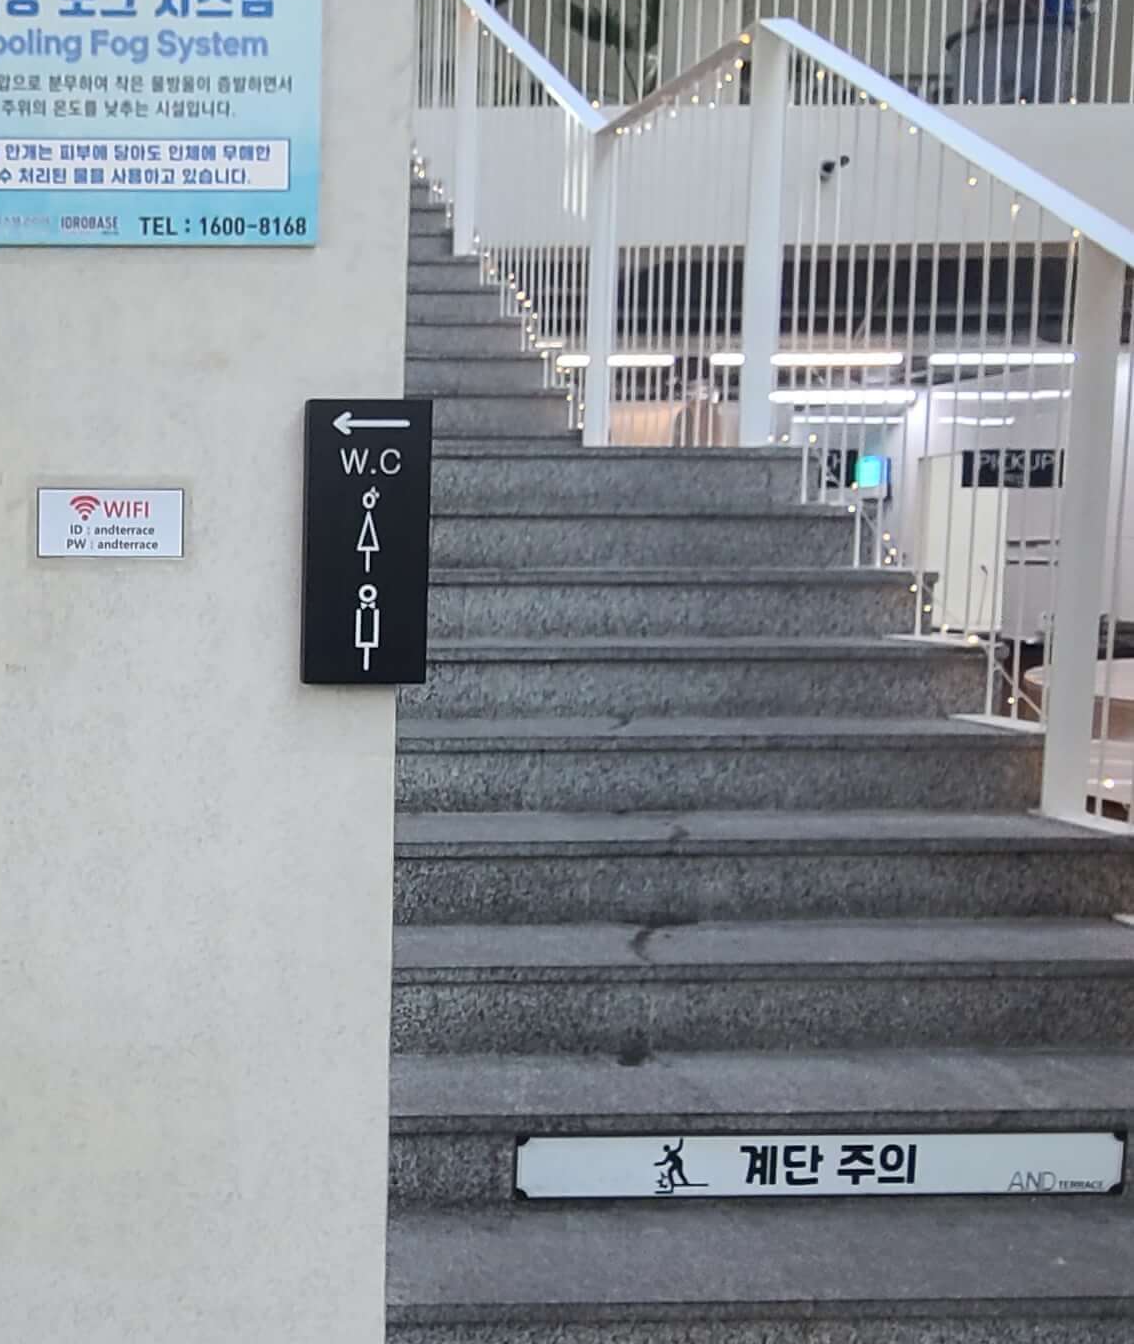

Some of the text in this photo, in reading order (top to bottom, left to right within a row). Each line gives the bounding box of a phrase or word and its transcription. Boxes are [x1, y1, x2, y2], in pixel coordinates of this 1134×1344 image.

[90, 29, 149, 63] Fog
[157, 29, 269, 64] System
[49, 74, 108, 92] 분무하여
[116, 75, 144, 92] 작은
[218, 75, 292, 93] 증발하면서
[2, 99, 236, 118] 주위의 온도를 낮추는 시설입니다.
[5, 144, 53, 160] 안개는
[60, 144, 108, 160] 피부에
[18, 167, 67, 184] 처리된
[111, 167, 175, 184] 사용하고
[182, 167, 251, 185] 있습니다.
[139, 216, 178, 235] TEL
[200, 216, 307, 236] 1600-8168
[341, 448, 402, 475] W.C
[104, 501, 150, 519] WIFI
[70, 524, 83, 535] ID
[94, 524, 155, 535] andterrace
[66, 539, 86, 549] PW
[97, 539, 159, 549] andterrace
[740, 1144, 918, 1186] 계단 주의
[1007, 1170, 1057, 1192] AND
